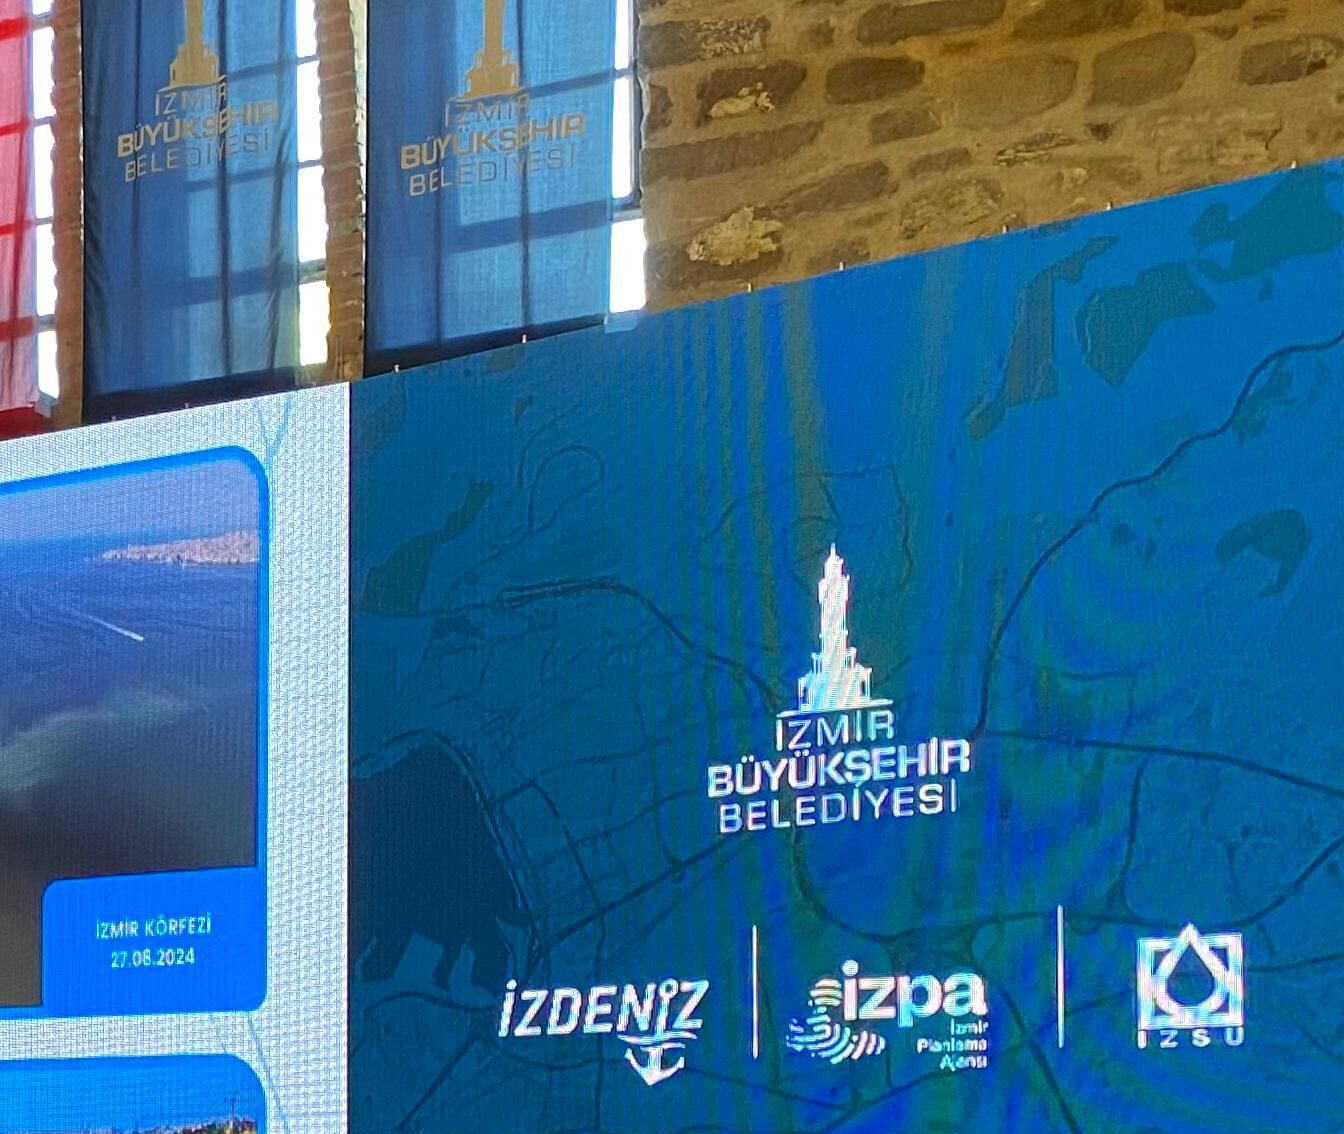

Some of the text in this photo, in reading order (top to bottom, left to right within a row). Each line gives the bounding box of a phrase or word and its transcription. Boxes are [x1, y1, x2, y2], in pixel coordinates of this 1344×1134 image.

[707, 736, 972, 799] BÜYÜKŞEHİR
[719, 777, 958, 834] BELEDİYESİ
[95, 911, 213, 940] İZMİR KÖRFEZİ
[841, 959, 989, 1028] izpa
